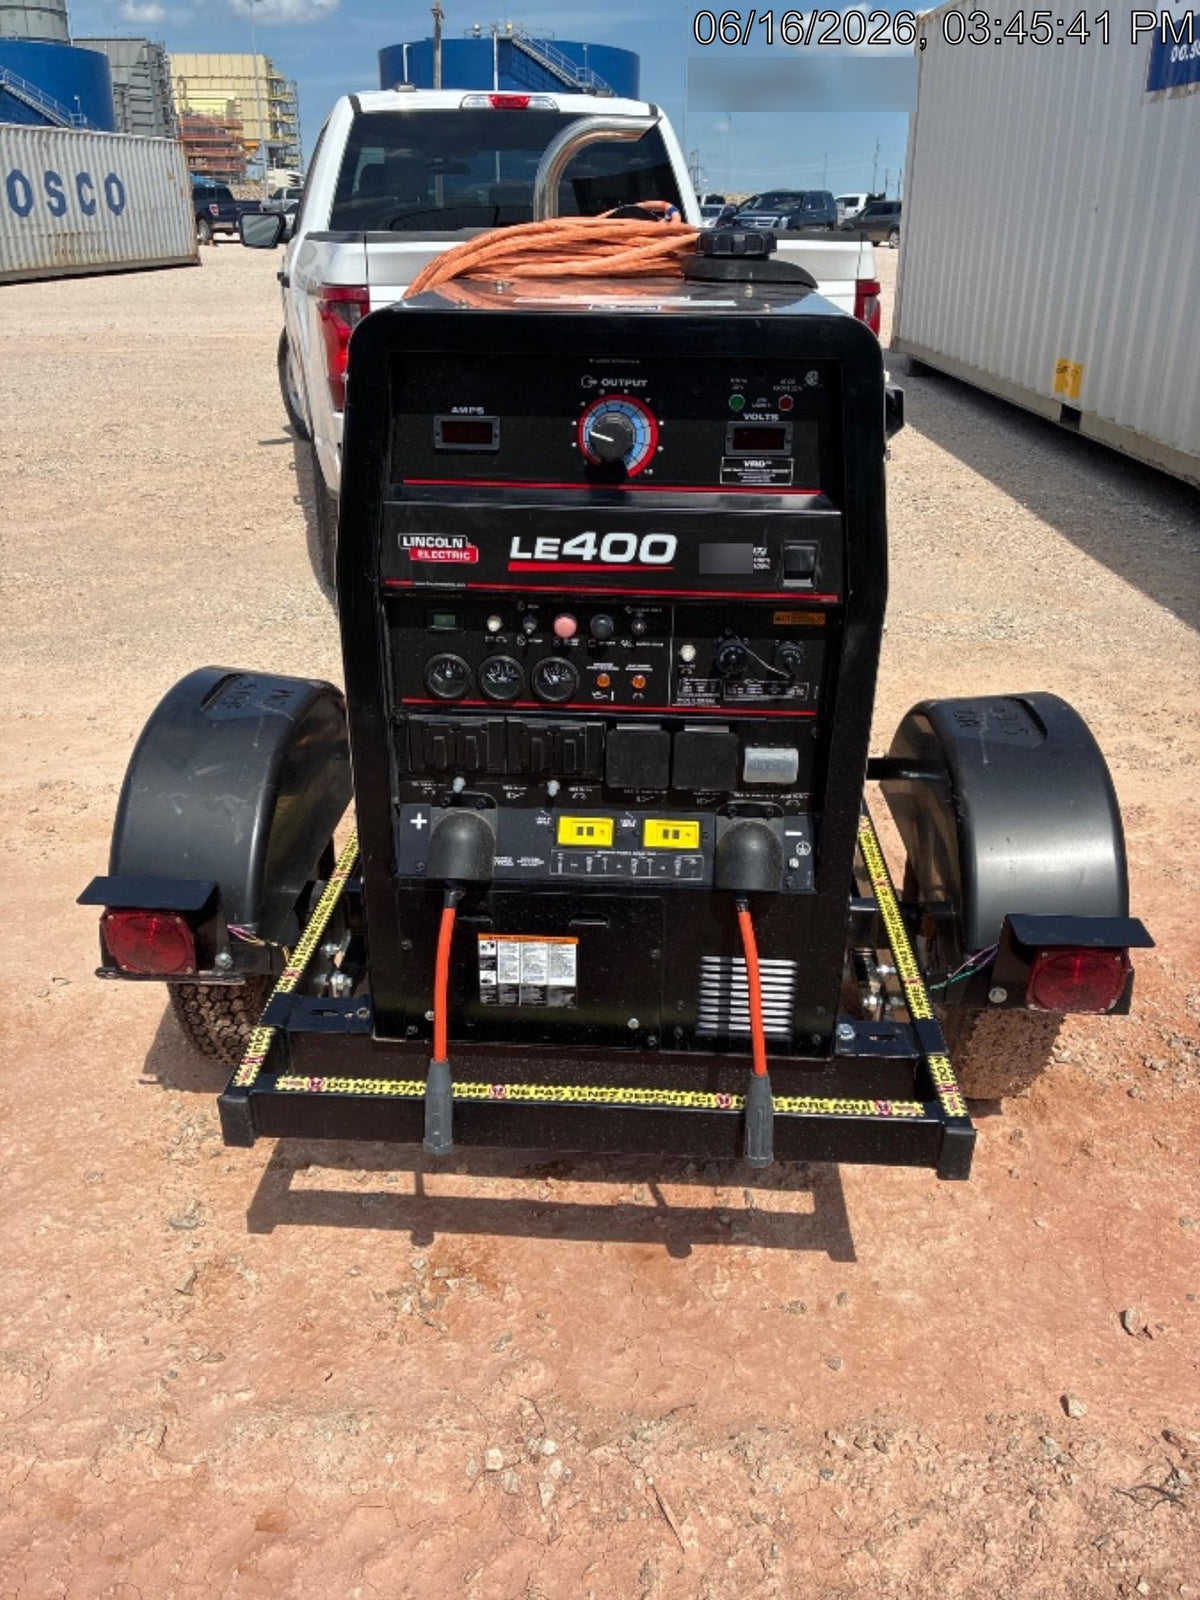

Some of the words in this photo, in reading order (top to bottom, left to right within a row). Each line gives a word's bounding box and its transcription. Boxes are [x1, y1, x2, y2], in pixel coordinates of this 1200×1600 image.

[6, 168, 126, 217] OSCO
[601, 378, 649, 387] OUTPUT
[450, 406, 486, 415] AMPS
[743, 413, 780, 421] VOLTS
[402, 536, 464, 548] LINCOLN
[509, 531, 678, 564] LE400
[417, 550, 471, 560] ELECTRIC
[353, 1082, 386, 1090] NOT
[389, 1084, 426, 1092] STAN
[534, 1089, 566, 1098] PAS
[568, 1090, 620, 1099] TENEZ
[623, 1091, 687, 1101] DEBOUT
[691, 1095, 712, 1103] ICI
[788, 1101, 830, 1109] PARE
[833, 1103, 871, 1111] AQUI
